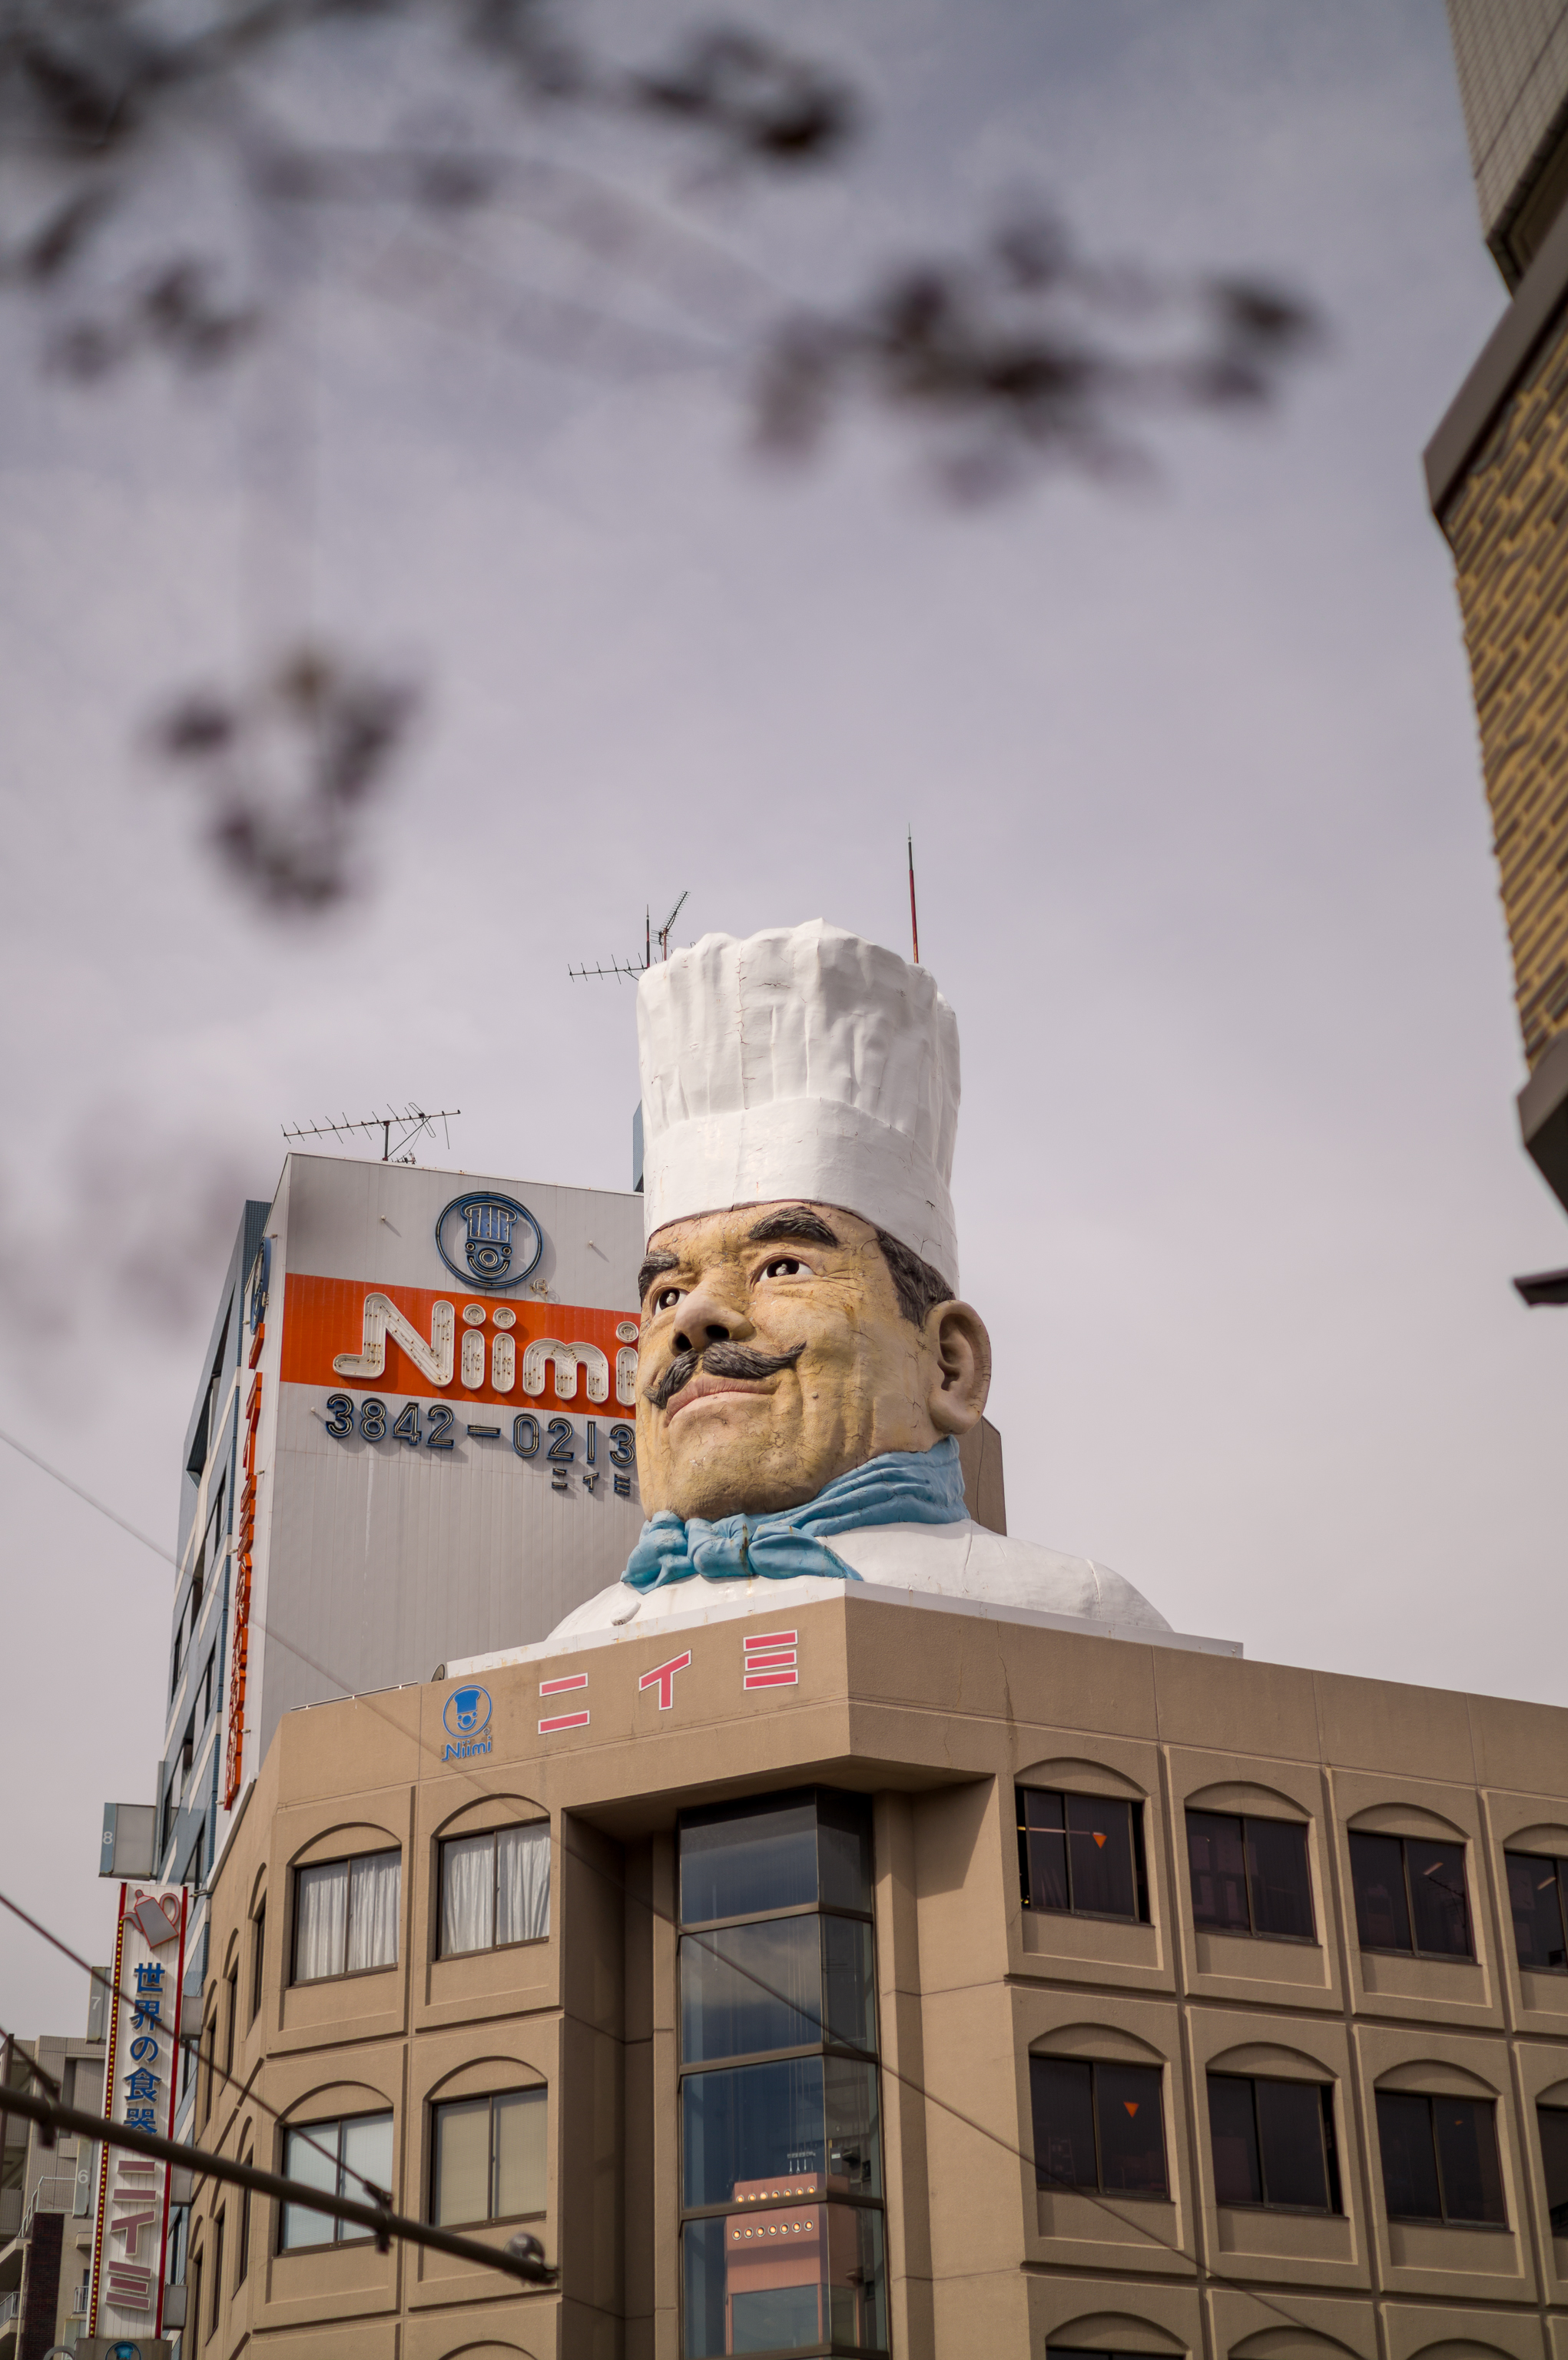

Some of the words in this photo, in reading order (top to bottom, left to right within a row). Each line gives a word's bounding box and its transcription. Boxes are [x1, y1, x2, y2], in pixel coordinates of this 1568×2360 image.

[332, 1292, 639, 1407] Niimi
[325, 1393, 636, 1467] 3842-0213
[551, 1467, 631, 1497] ニイミ
[538, 1629, 799, 1736] ニイミ
[441, 1735, 492, 1762] Niimi
[102, 1831, 113, 1845] 8
[91, 1996, 101, 2010] 7
[77, 2169, 88, 2184] 6
[104, 2159, 157, 2311] ニイミ
